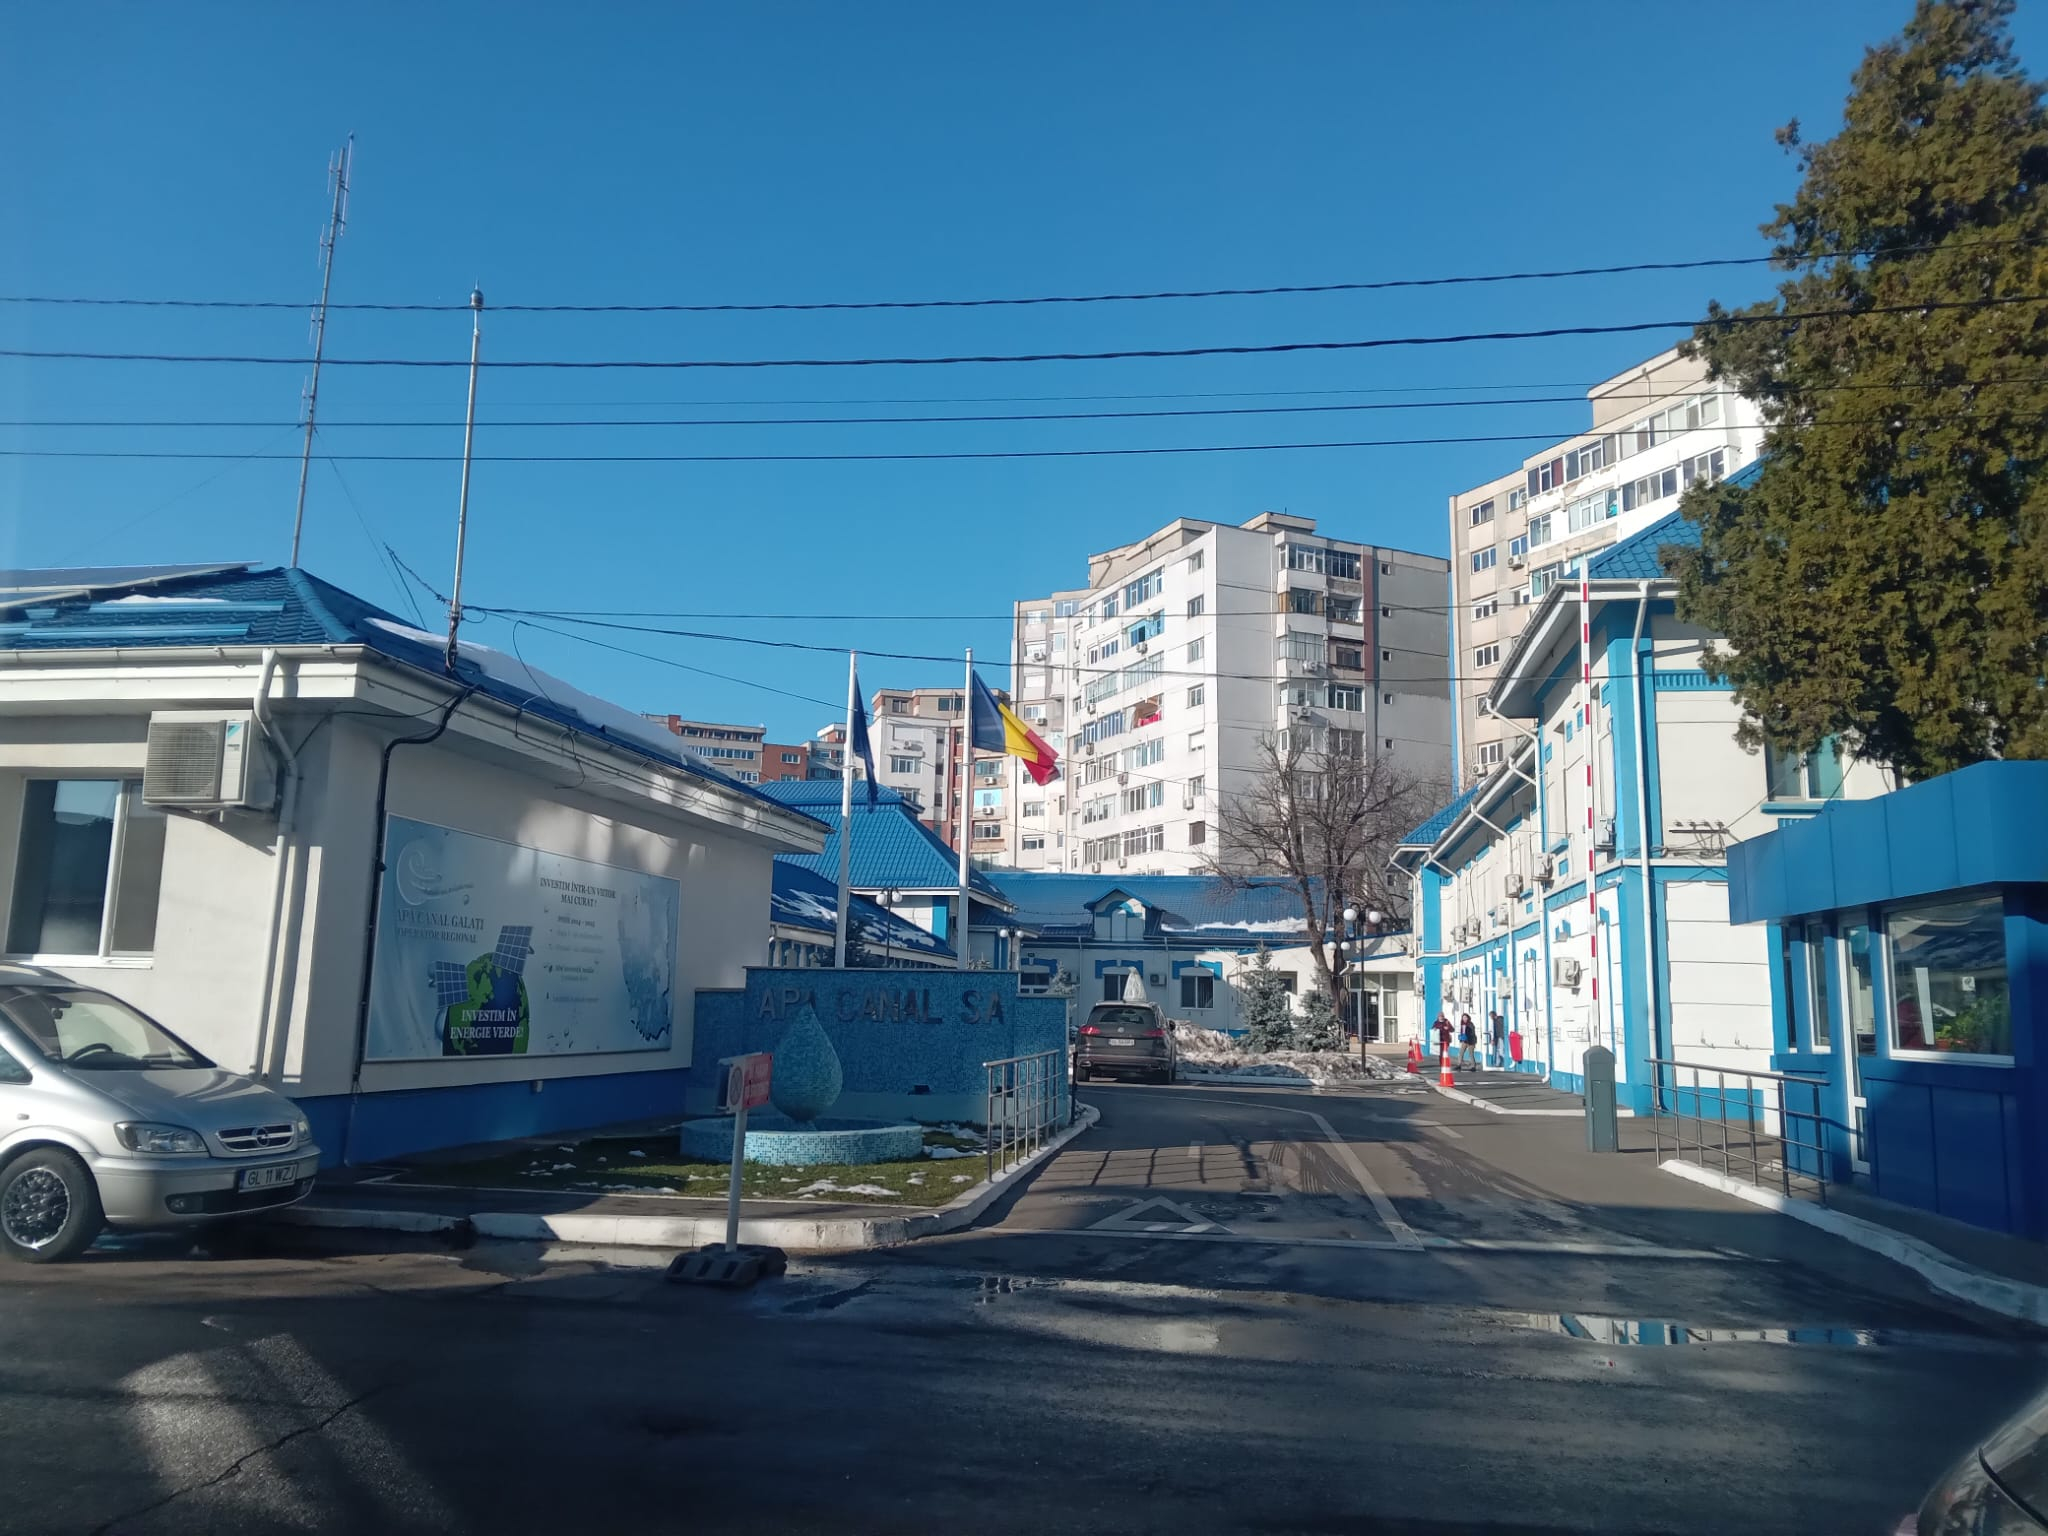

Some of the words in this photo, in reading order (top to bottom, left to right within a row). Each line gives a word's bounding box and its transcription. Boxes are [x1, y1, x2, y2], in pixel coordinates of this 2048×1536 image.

[540, 878, 570, 891] INVESTIM
[561, 894, 573, 904] MAI
[574, 896, 593, 907] CURAT
[442, 930, 476, 944] REGIONAL
[836, 988, 943, 1024] CANAL
[961, 989, 1005, 1025] SA
[462, 1009, 505, 1021] INVESTIM
[506, 1007, 517, 1021] ÎN
[450, 1026, 491, 1039] ENERGIE
[248, 1171, 260, 1185] GL
[266, 1169, 273, 1184] 11
